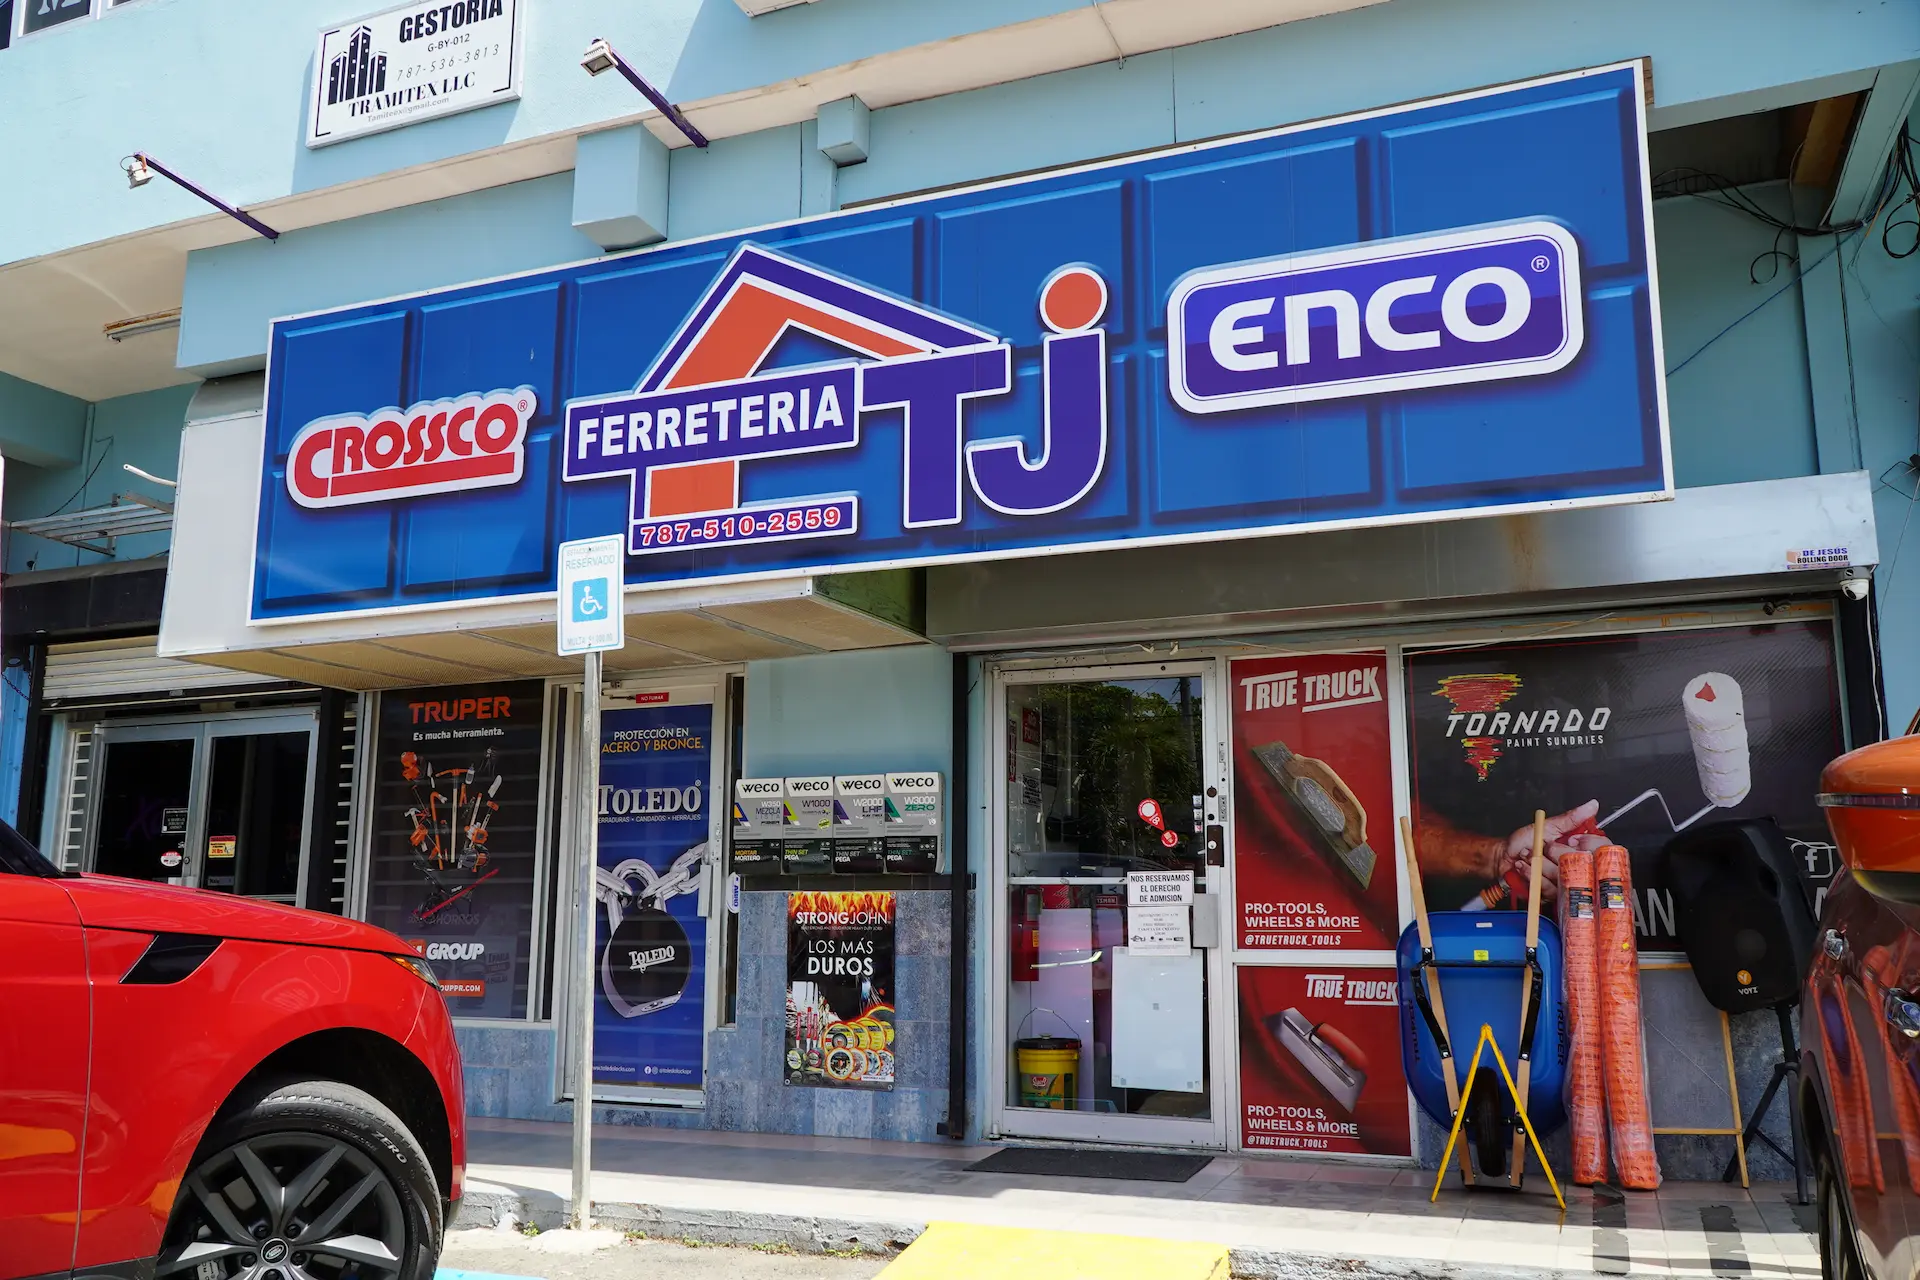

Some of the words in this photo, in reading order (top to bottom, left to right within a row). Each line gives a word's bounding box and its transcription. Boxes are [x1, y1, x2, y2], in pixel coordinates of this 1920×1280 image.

[427, 33, 471, 53] G-BY-012
[396, 44, 500, 81] 787-536-3813
[348, 80, 439, 118] TRAMITEX
[442, 71, 476, 94] LLC
[577, 384, 845, 460] FERRETERIA
[294, 402, 519, 499] CROSSCO
[640, 506, 842, 547] 787-510-2559
[1797, 556, 1827, 564] ROLLING
[1802, 549, 1815, 557] DE
[565, 554, 616, 571] RESERVADO
[1240, 670, 1299, 711] TRUE
[1302, 666, 1382, 709] TRUCK
[408, 695, 512, 725] TRUPER
[1446, 707, 1612, 737] TORNADO
[413, 732, 424, 741] Es
[425, 730, 451, 741] mucha
[453, 727, 505, 739] herramienta.
[613, 726, 674, 741] PROTECCIÓN
[676, 727, 689, 738] EN
[601, 740, 640, 754] ACERO
[643, 740, 651, 751] Y
[653, 737, 705, 751] BRONCE.
[1506, 737, 1541, 748] PAINT
[1546, 734, 1605, 746] SUNDRIES
[741, 783, 780, 794] weco
[791, 781, 830, 792] weco
[840, 779, 882, 790] weco
[891, 777, 935, 788] weco
[801, 800, 831, 808] W1000
[853, 798, 884, 807] W2000
[904, 796, 936, 805] W3000
[635, 815, 666, 823] CANDADOS
[672, 813, 702, 821] HERRAJES
[755, 807, 781, 815] MEZCLA
[1145, 874, 1190, 882] RESERVAMOS
[1150, 884, 1181, 892] DERECHO
[1149, 894, 1183, 902] ADMISION
[1245, 902, 1328, 916] PRO-TOOLS,
[1245, 916, 1304, 928] WHEELS
[1306, 916, 1316, 928] &
[1317, 916, 1360, 928] MORE
[808, 939, 835, 954] LOS
[840, 937, 874, 955] MÁS
[1245, 934, 1342, 946] @TRUETRUCK_TOOLS
[426, 942, 485, 961] GROUP
[807, 956, 874, 976] DUROS
[1304, 974, 1345, 999] TRUE
[1346, 980, 1399, 1003] TRUCK
[1247, 1105, 1327, 1121] PRO-TOOLS,
[1247, 1118, 1303, 1132] WHEELS
[1306, 1120, 1316, 1132] &
[1317, 1121, 1358, 1135] MORE
[371, 1130, 408, 1164] ZERO
[1247, 1136, 1328, 1149] @TRUETRUCK_TOOLS
